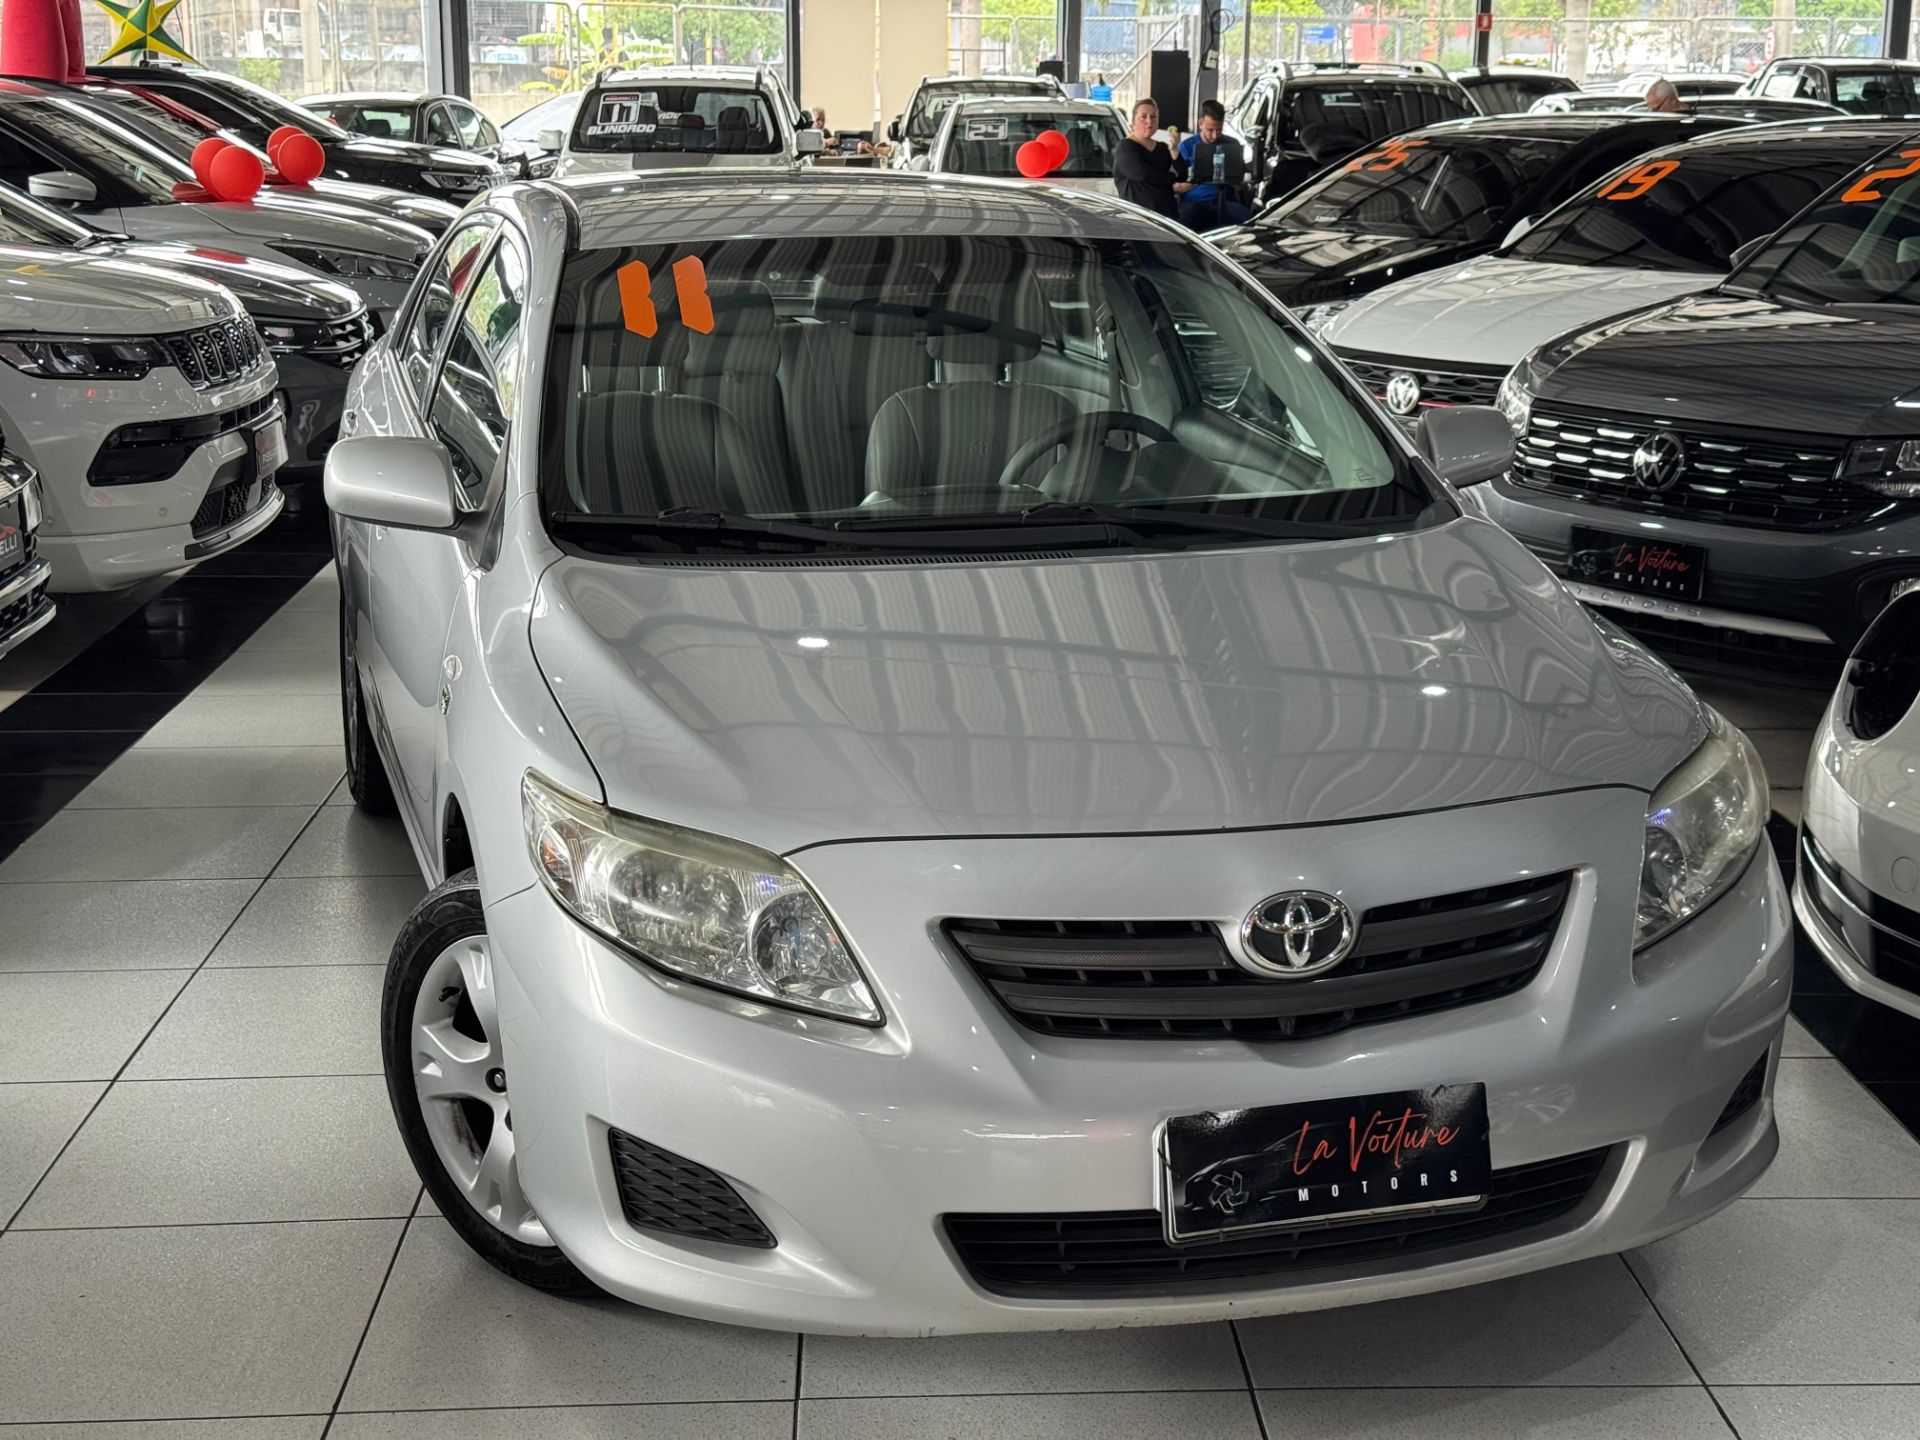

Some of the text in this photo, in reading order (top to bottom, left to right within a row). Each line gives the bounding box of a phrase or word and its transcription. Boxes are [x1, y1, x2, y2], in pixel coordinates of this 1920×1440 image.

[586, 123, 657, 136] BLINDADO
[968, 123, 1005, 140] 24
[1597, 160, 1682, 201] 19
[1637, 545, 1692, 577] Voiture
[1576, 586, 1703, 617] T-CROSS
[1292, 1107, 1461, 1176] La Voiture
[1298, 1168, 1458, 1202] MOTORS
